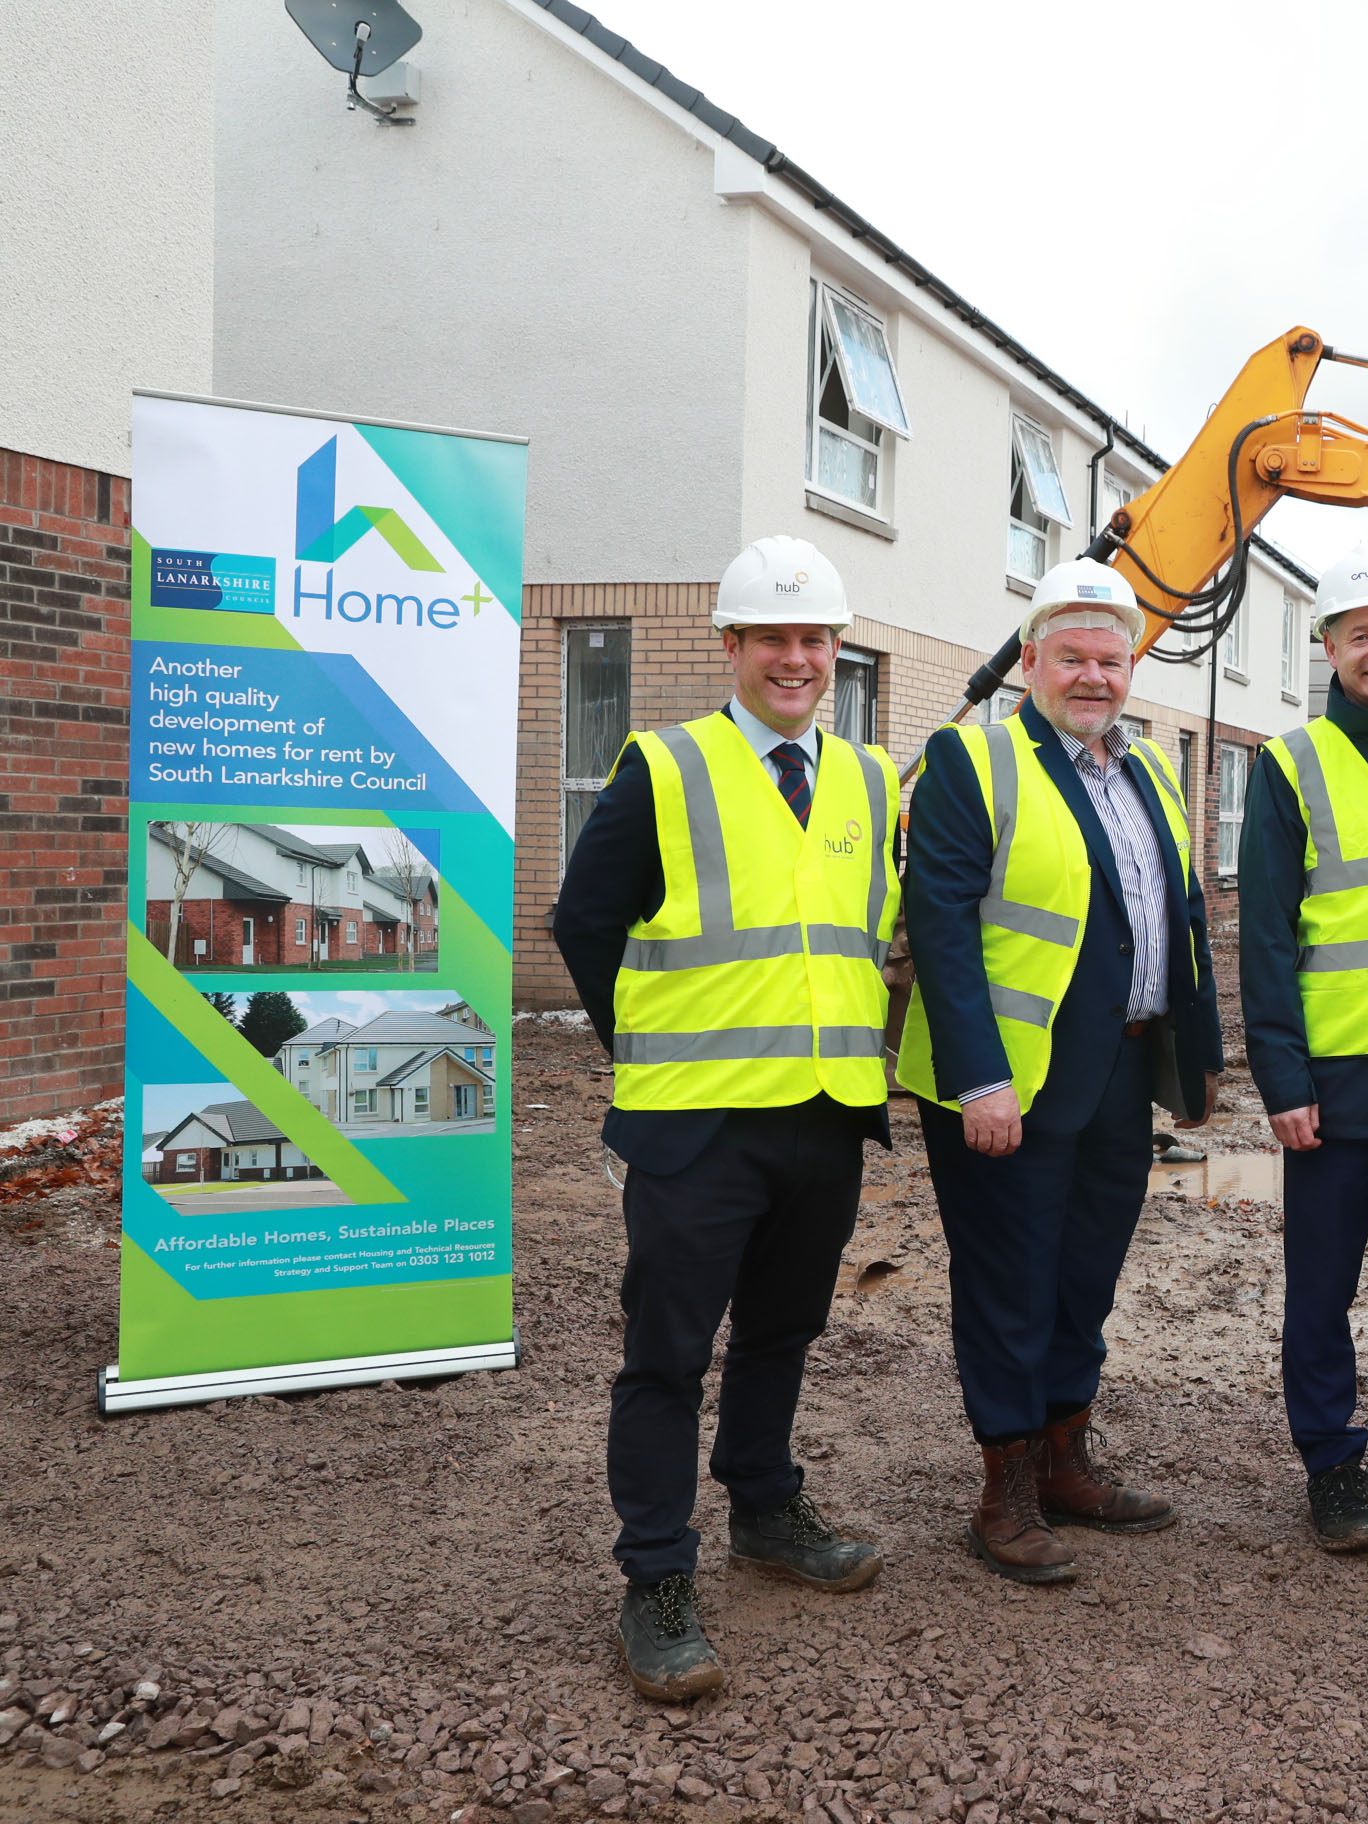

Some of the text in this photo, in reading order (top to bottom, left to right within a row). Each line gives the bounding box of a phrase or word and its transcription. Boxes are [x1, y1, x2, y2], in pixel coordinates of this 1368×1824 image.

[157, 557, 203, 567] SOUTH
[157, 572, 271, 590] LANARKSHIRE
[775, 581, 800, 593] hub
[225, 595, 270, 604] COUNCIL
[149, 656, 242, 679] Another
[149, 681, 280, 712] high quality
[149, 709, 326, 737] development of
[149, 737, 396, 770] new homes for rent by
[148, 762, 426, 791] South Lanarkshire Council
[823, 833, 854, 854] hub
[154, 1218, 496, 1252] Affordable Homes, Sustainable Places
[185, 1242, 496, 1271] For further information please contact Housing and Technical Resources
[273, 1250, 496, 1277] Strategy and Support Team on 0303 123 1012
